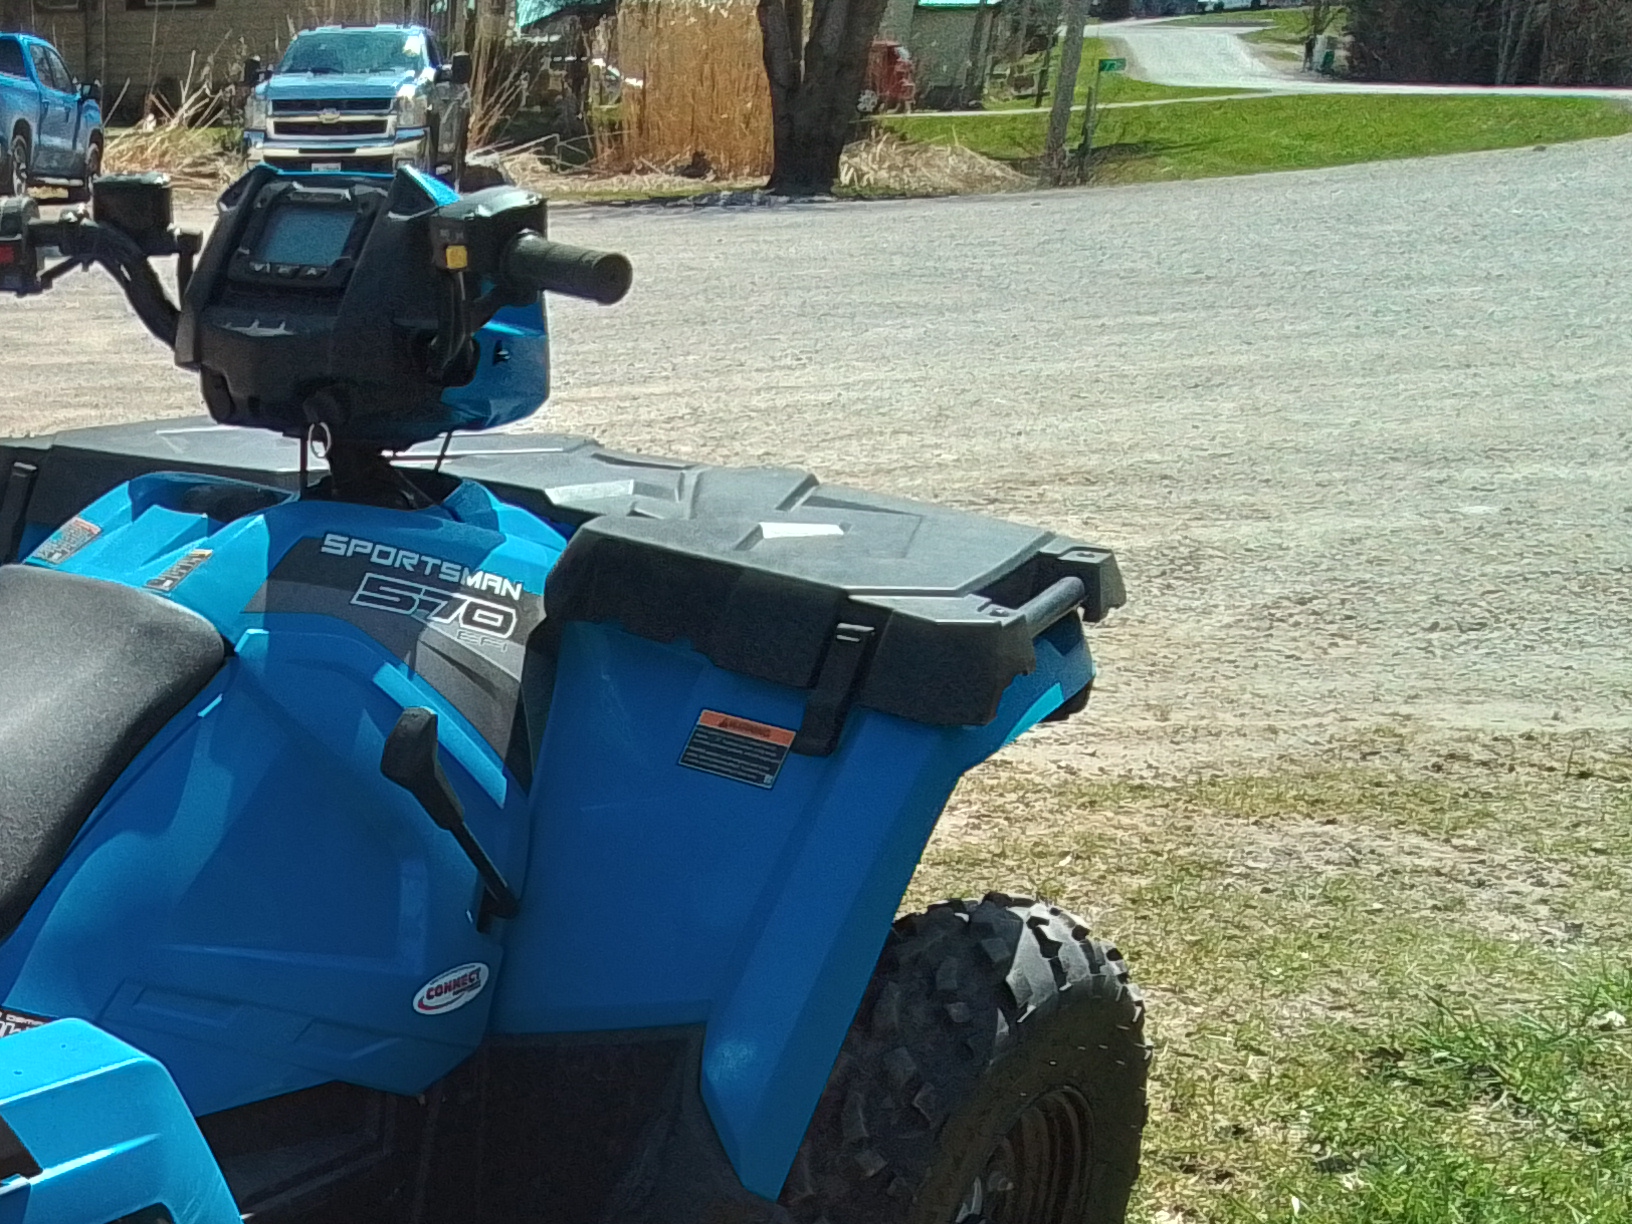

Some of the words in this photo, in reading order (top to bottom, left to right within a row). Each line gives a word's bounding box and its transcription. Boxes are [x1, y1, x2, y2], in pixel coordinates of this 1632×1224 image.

[321, 533, 523, 601] SPORTSMAN
[350, 572, 518, 639] 570
[425, 966, 482, 1001] CONNECT
